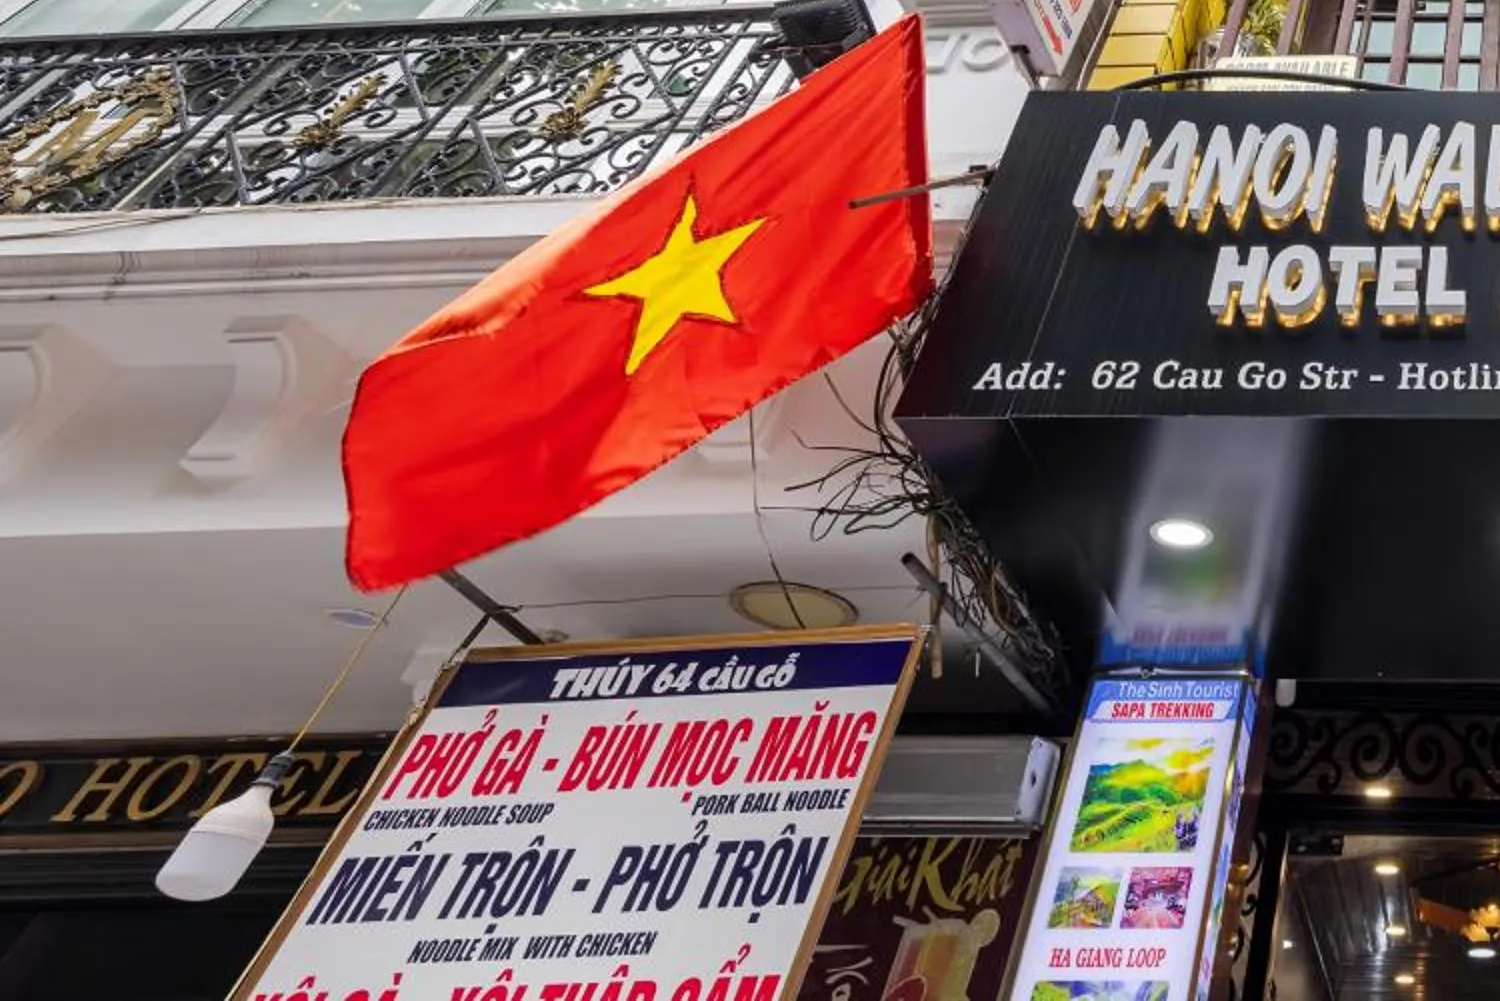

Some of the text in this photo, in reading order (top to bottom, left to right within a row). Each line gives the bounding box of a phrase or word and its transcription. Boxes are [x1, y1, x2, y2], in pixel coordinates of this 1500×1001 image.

[1072, 118, 1338, 227] HANOI
[1208, 244, 1467, 323] HOTEL
[972, 361, 1067, 391] Add:
[1090, 360, 1141, 390] 62
[1152, 360, 1223, 390] Cau
[1236, 361, 1287, 390] Go
[1299, 361, 1360, 390] Str
[549, 656, 655, 699] THÚY
[651, 662, 699, 694] 64
[699, 654, 756, 692] CẦU
[1118, 680, 1240, 699] The Sinh Tourist
[1111, 701, 1215, 719] SAPA TREKKING
[383, 708, 497, 800] PHỞ
[471, 714, 550, 796] GÀ
[557, 710, 662, 792] BÚN
[652, 715, 754, 804] MỌC
[744, 699, 878, 783] MĂNG
[50, 750, 364, 822] HOTEL
[691, 788, 851, 817] PORK BALL NOODLE
[363, 802, 554, 832] CHICKEN NOODLE SOUP
[306, 833, 453, 926] MIẾN
[437, 834, 577, 934] TRỘN
[592, 820, 708, 915] PHỞ
[698, 822, 830, 924] TRỘN
[407, 930, 659, 965] NOODLE MIX WITH CHICKEN
[1048, 947, 1167, 968] HA GIANG LOOP
